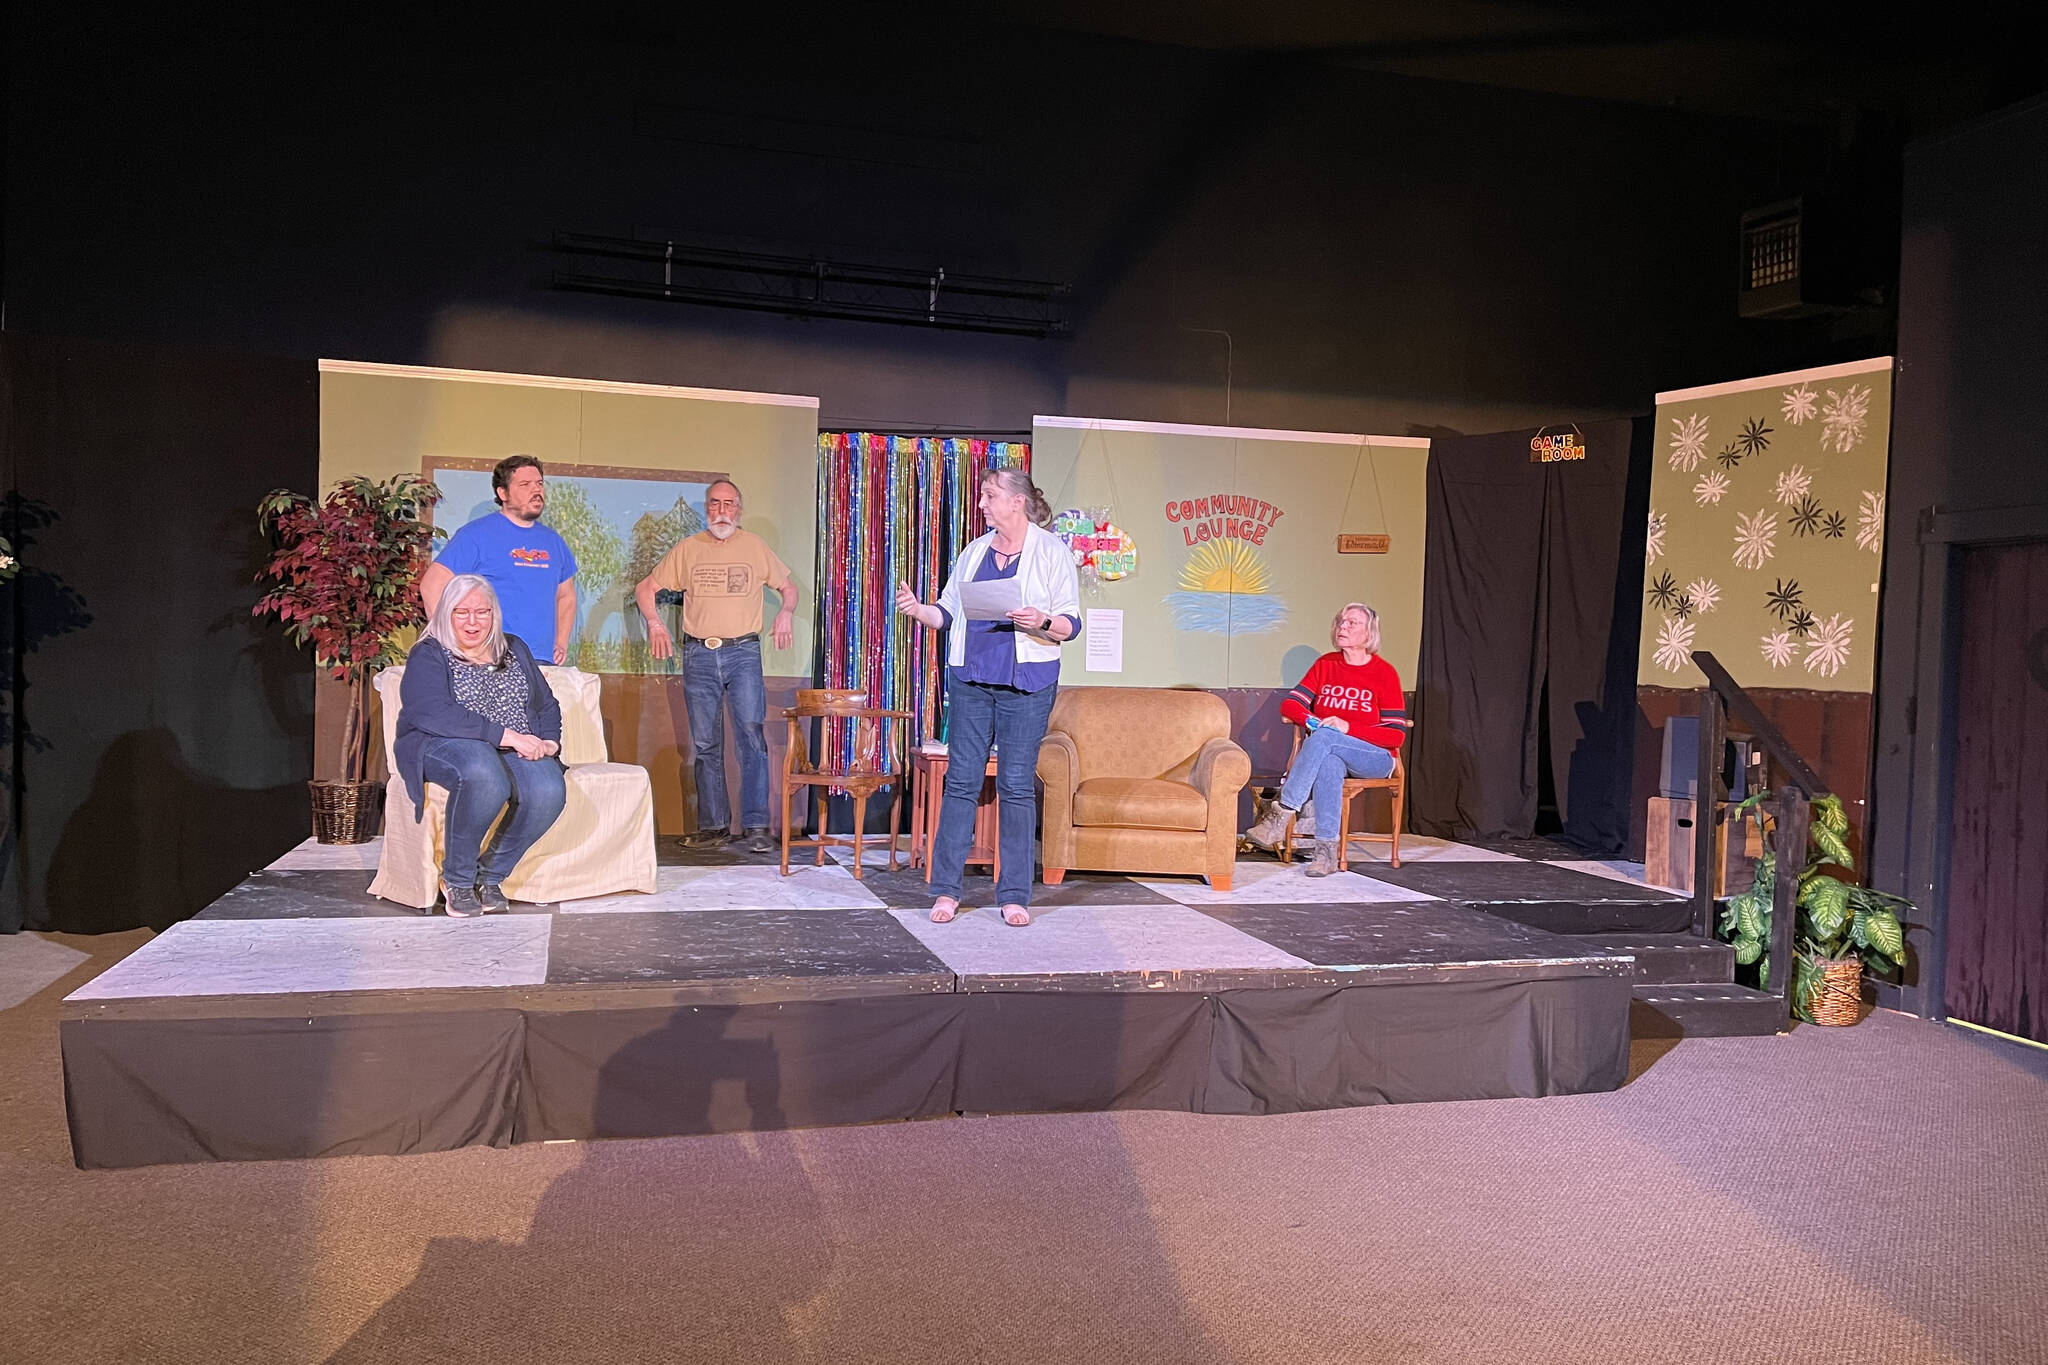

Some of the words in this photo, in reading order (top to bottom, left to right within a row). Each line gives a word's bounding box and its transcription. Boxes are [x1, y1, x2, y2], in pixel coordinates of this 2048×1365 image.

[1531, 434, 1573, 451] GAME
[1542, 446, 1585, 462] ROOM
[1166, 494, 1284, 527] COMMUNITY
[1183, 518, 1268, 546] LOUNGE
[1321, 684, 1373, 701] GOOD
[1316, 695, 1373, 712] TIMES
